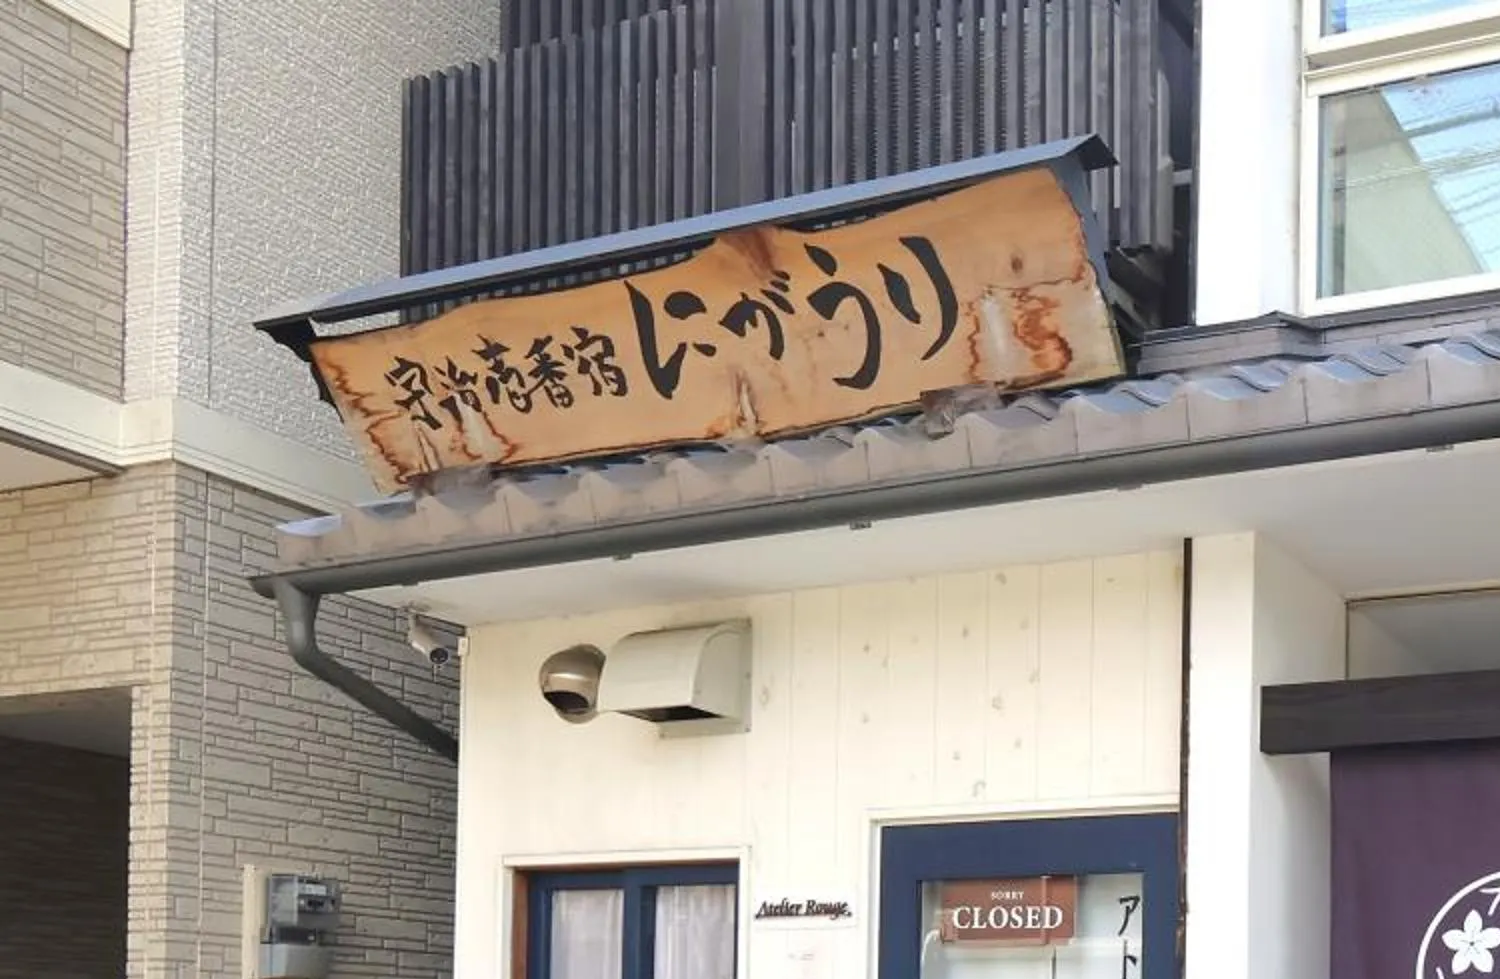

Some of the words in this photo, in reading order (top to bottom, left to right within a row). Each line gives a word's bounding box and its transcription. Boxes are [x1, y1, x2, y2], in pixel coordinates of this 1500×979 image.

[623, 236, 958, 400] にがうり
[753, 897, 803, 919] Atelier
[952, 905, 1063, 930] CLOSED
